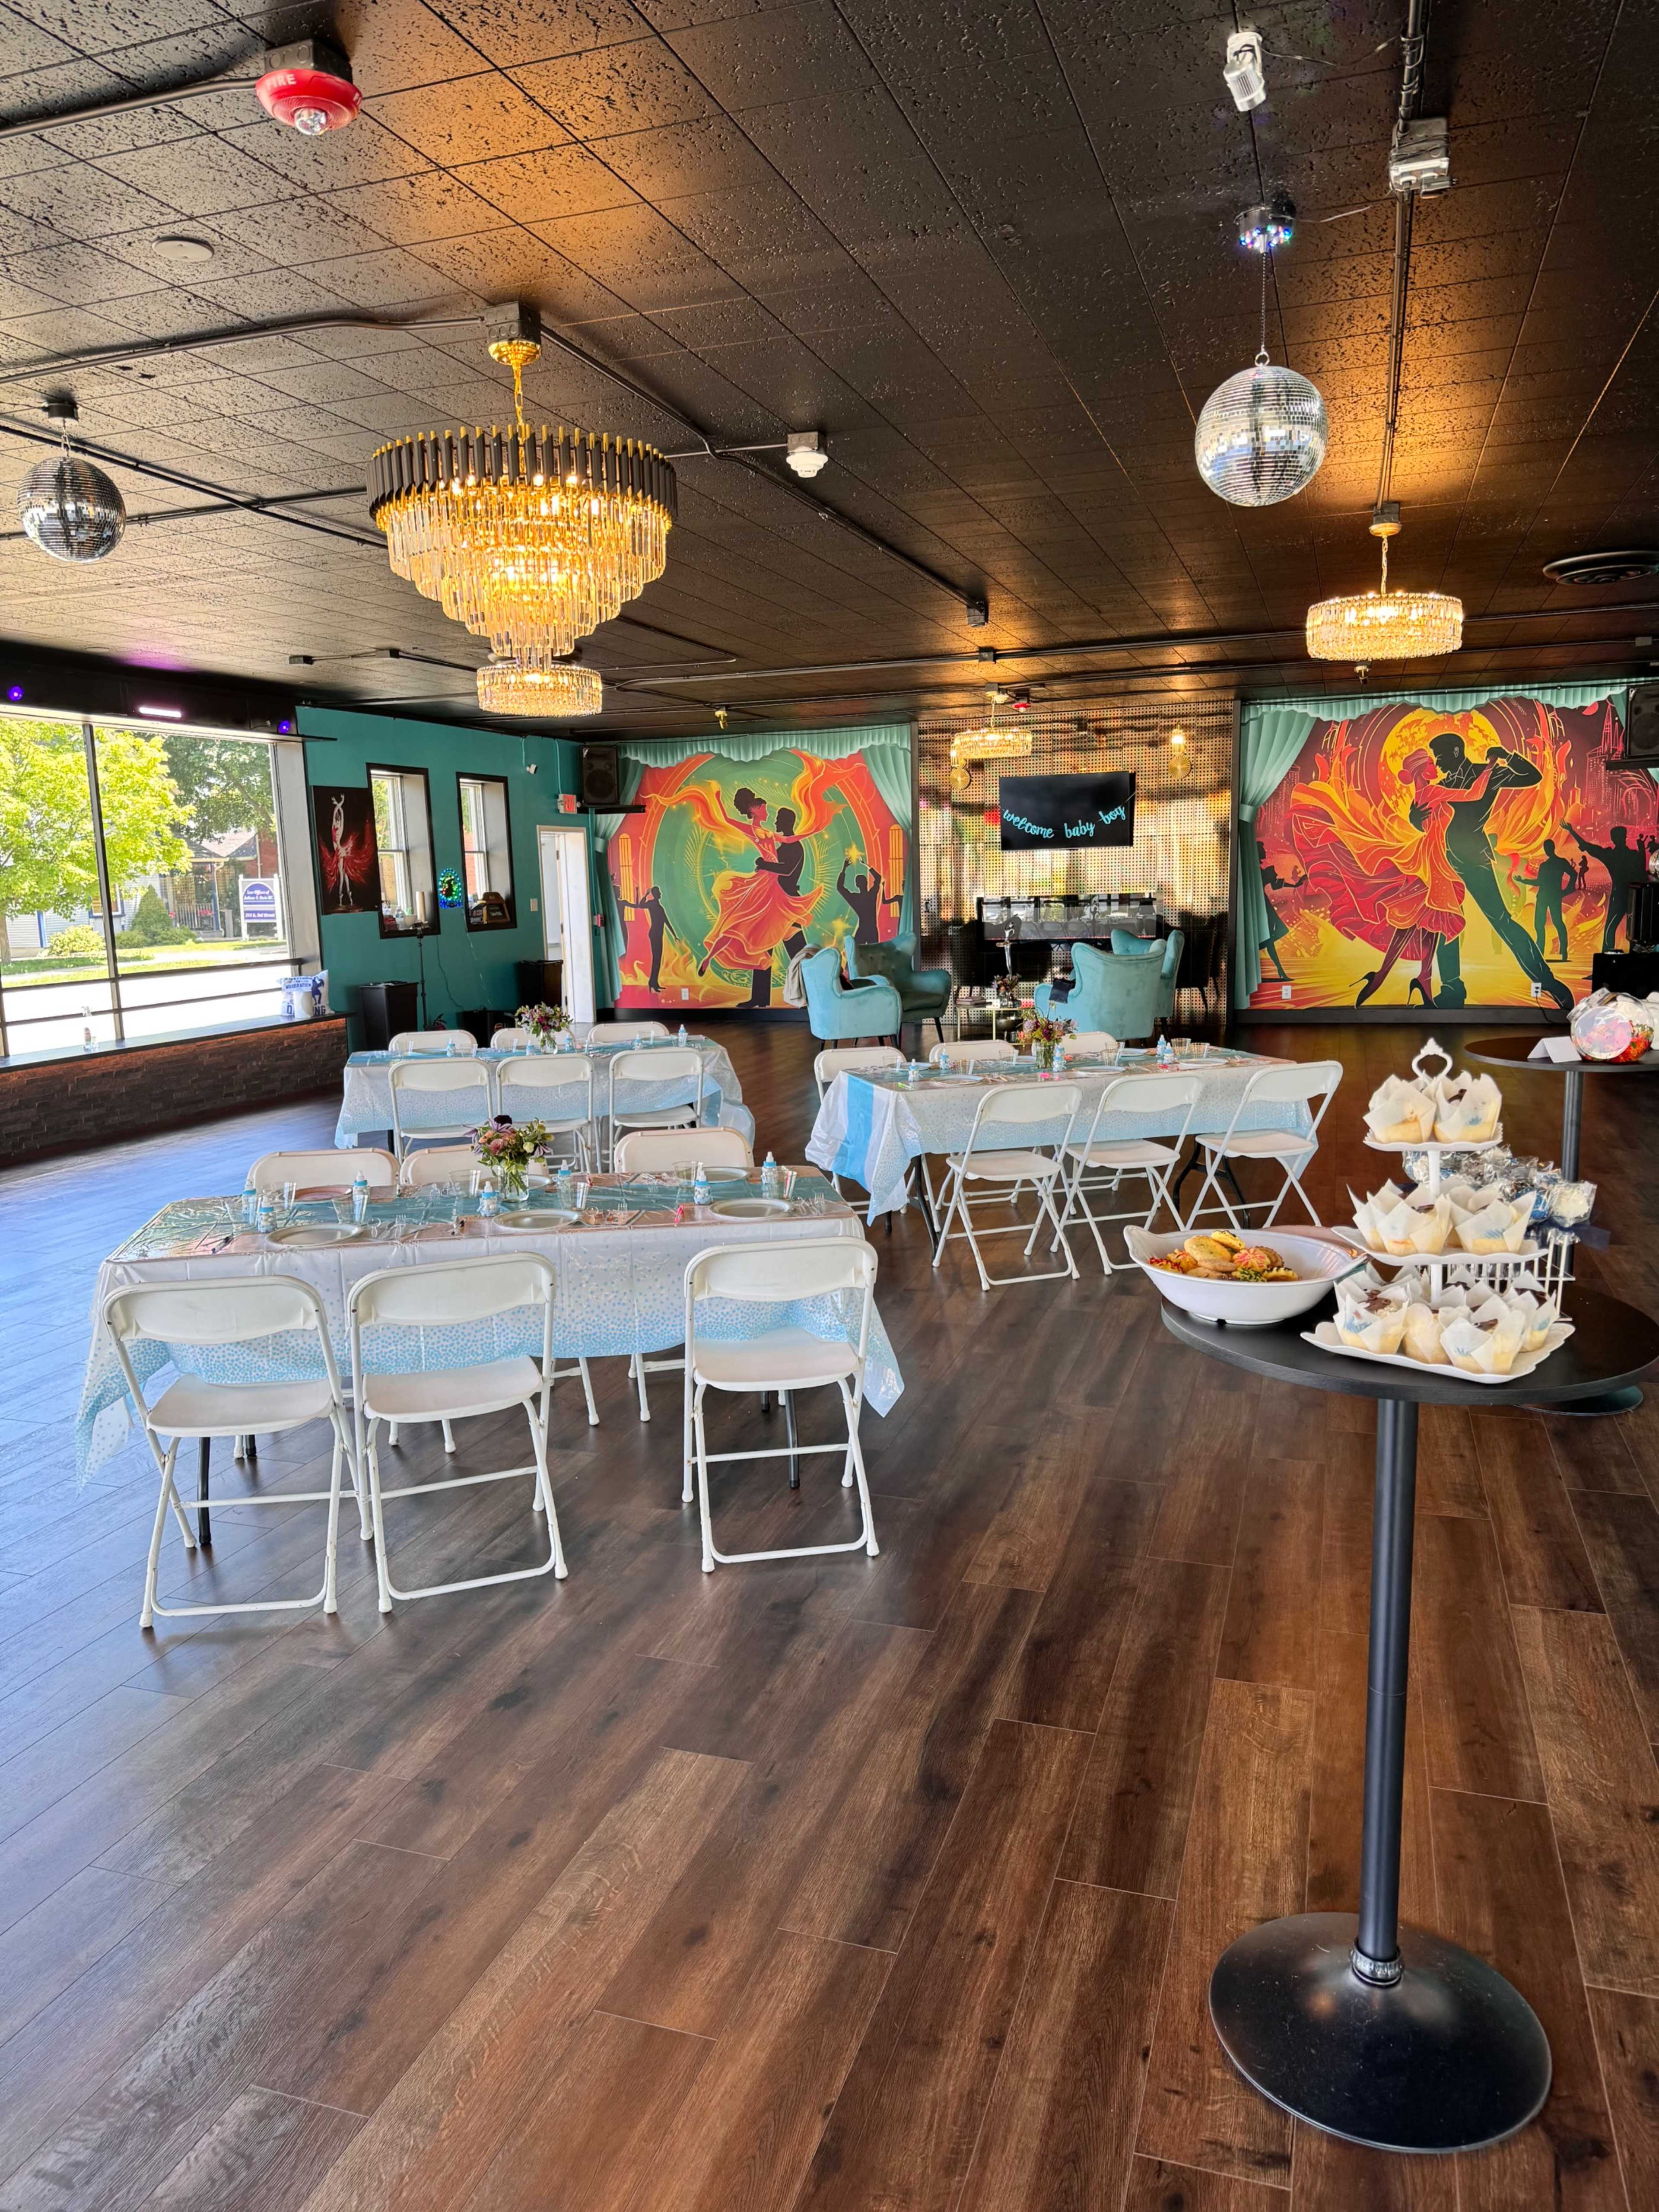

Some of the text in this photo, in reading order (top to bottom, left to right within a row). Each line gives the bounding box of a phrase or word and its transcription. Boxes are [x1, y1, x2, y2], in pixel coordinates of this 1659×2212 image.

[266, 73, 297, 90] FIRE
[1003, 805, 1126, 838] welcome baby boy
